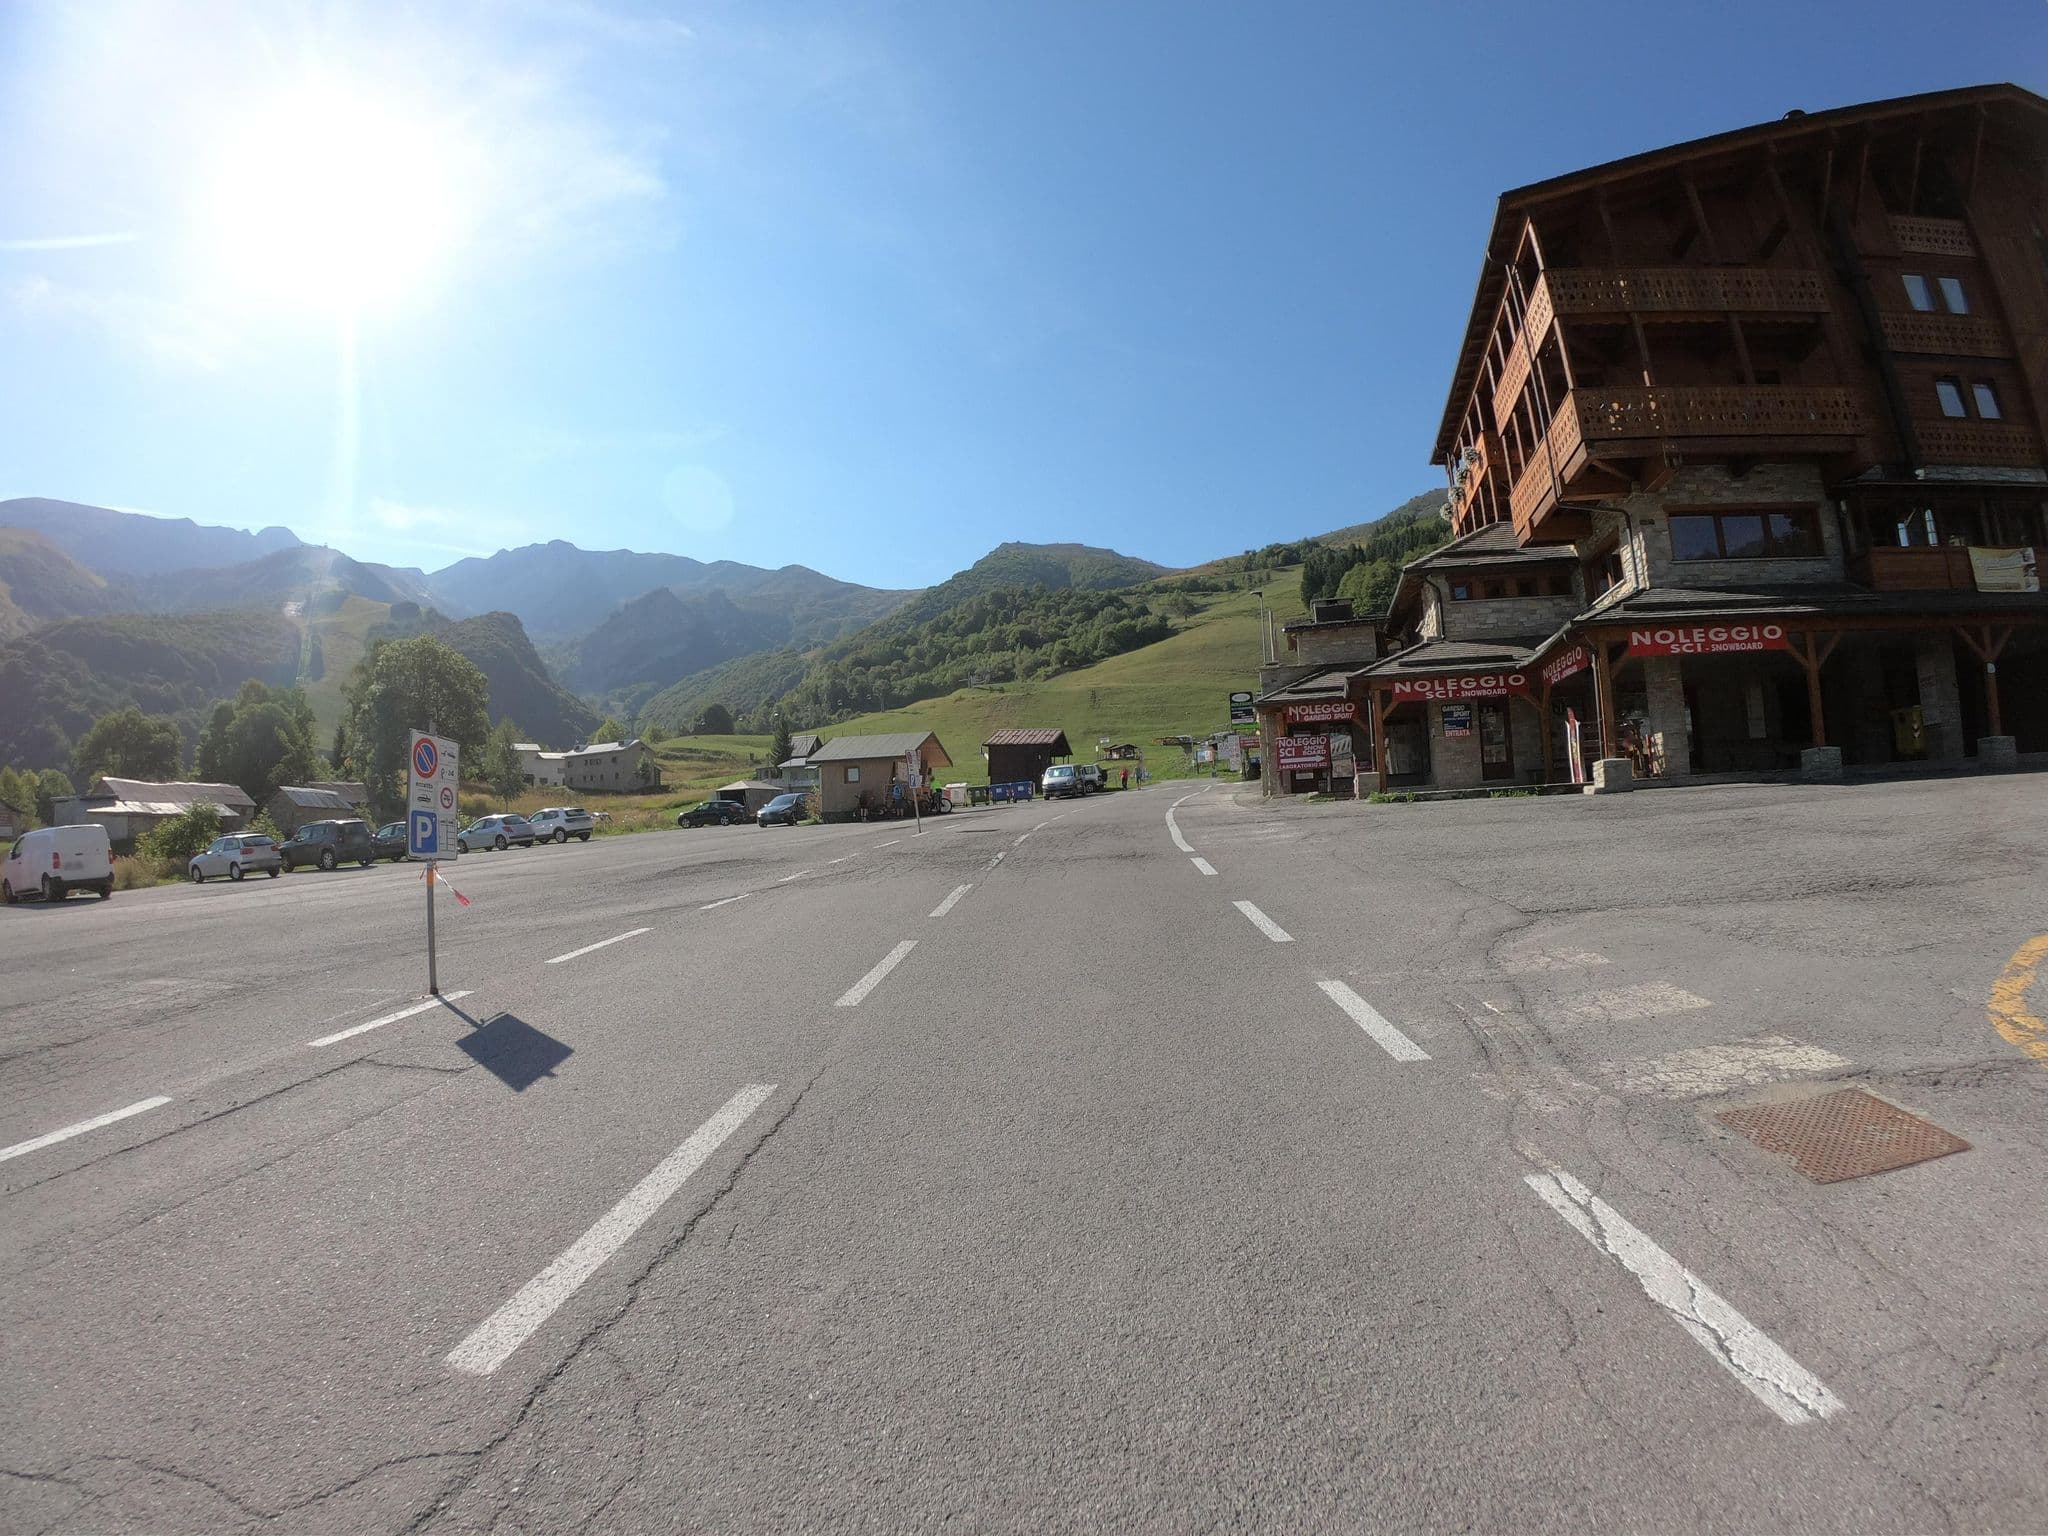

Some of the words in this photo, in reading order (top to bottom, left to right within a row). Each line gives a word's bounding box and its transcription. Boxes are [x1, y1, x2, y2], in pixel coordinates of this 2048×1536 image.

[1631, 625, 1783, 646] NOLEGGIO
[1670, 643, 1702, 654] SCI
[1711, 642, 1763, 652] SNOWBOARD
[1542, 646, 1582, 680] NOLEGGIO
[1394, 674, 1526, 694] NOLEGGIO
[1426, 690, 1453, 699] SCI
[1461, 688, 1507, 697] SNOWBOARD
[1288, 703, 1355, 720] NOLEGGIO
[1445, 729, 1471, 737] ENTRATA
[1278, 736, 1327, 747] NOLEGGIO
[1279, 748, 1295, 757] SCI
